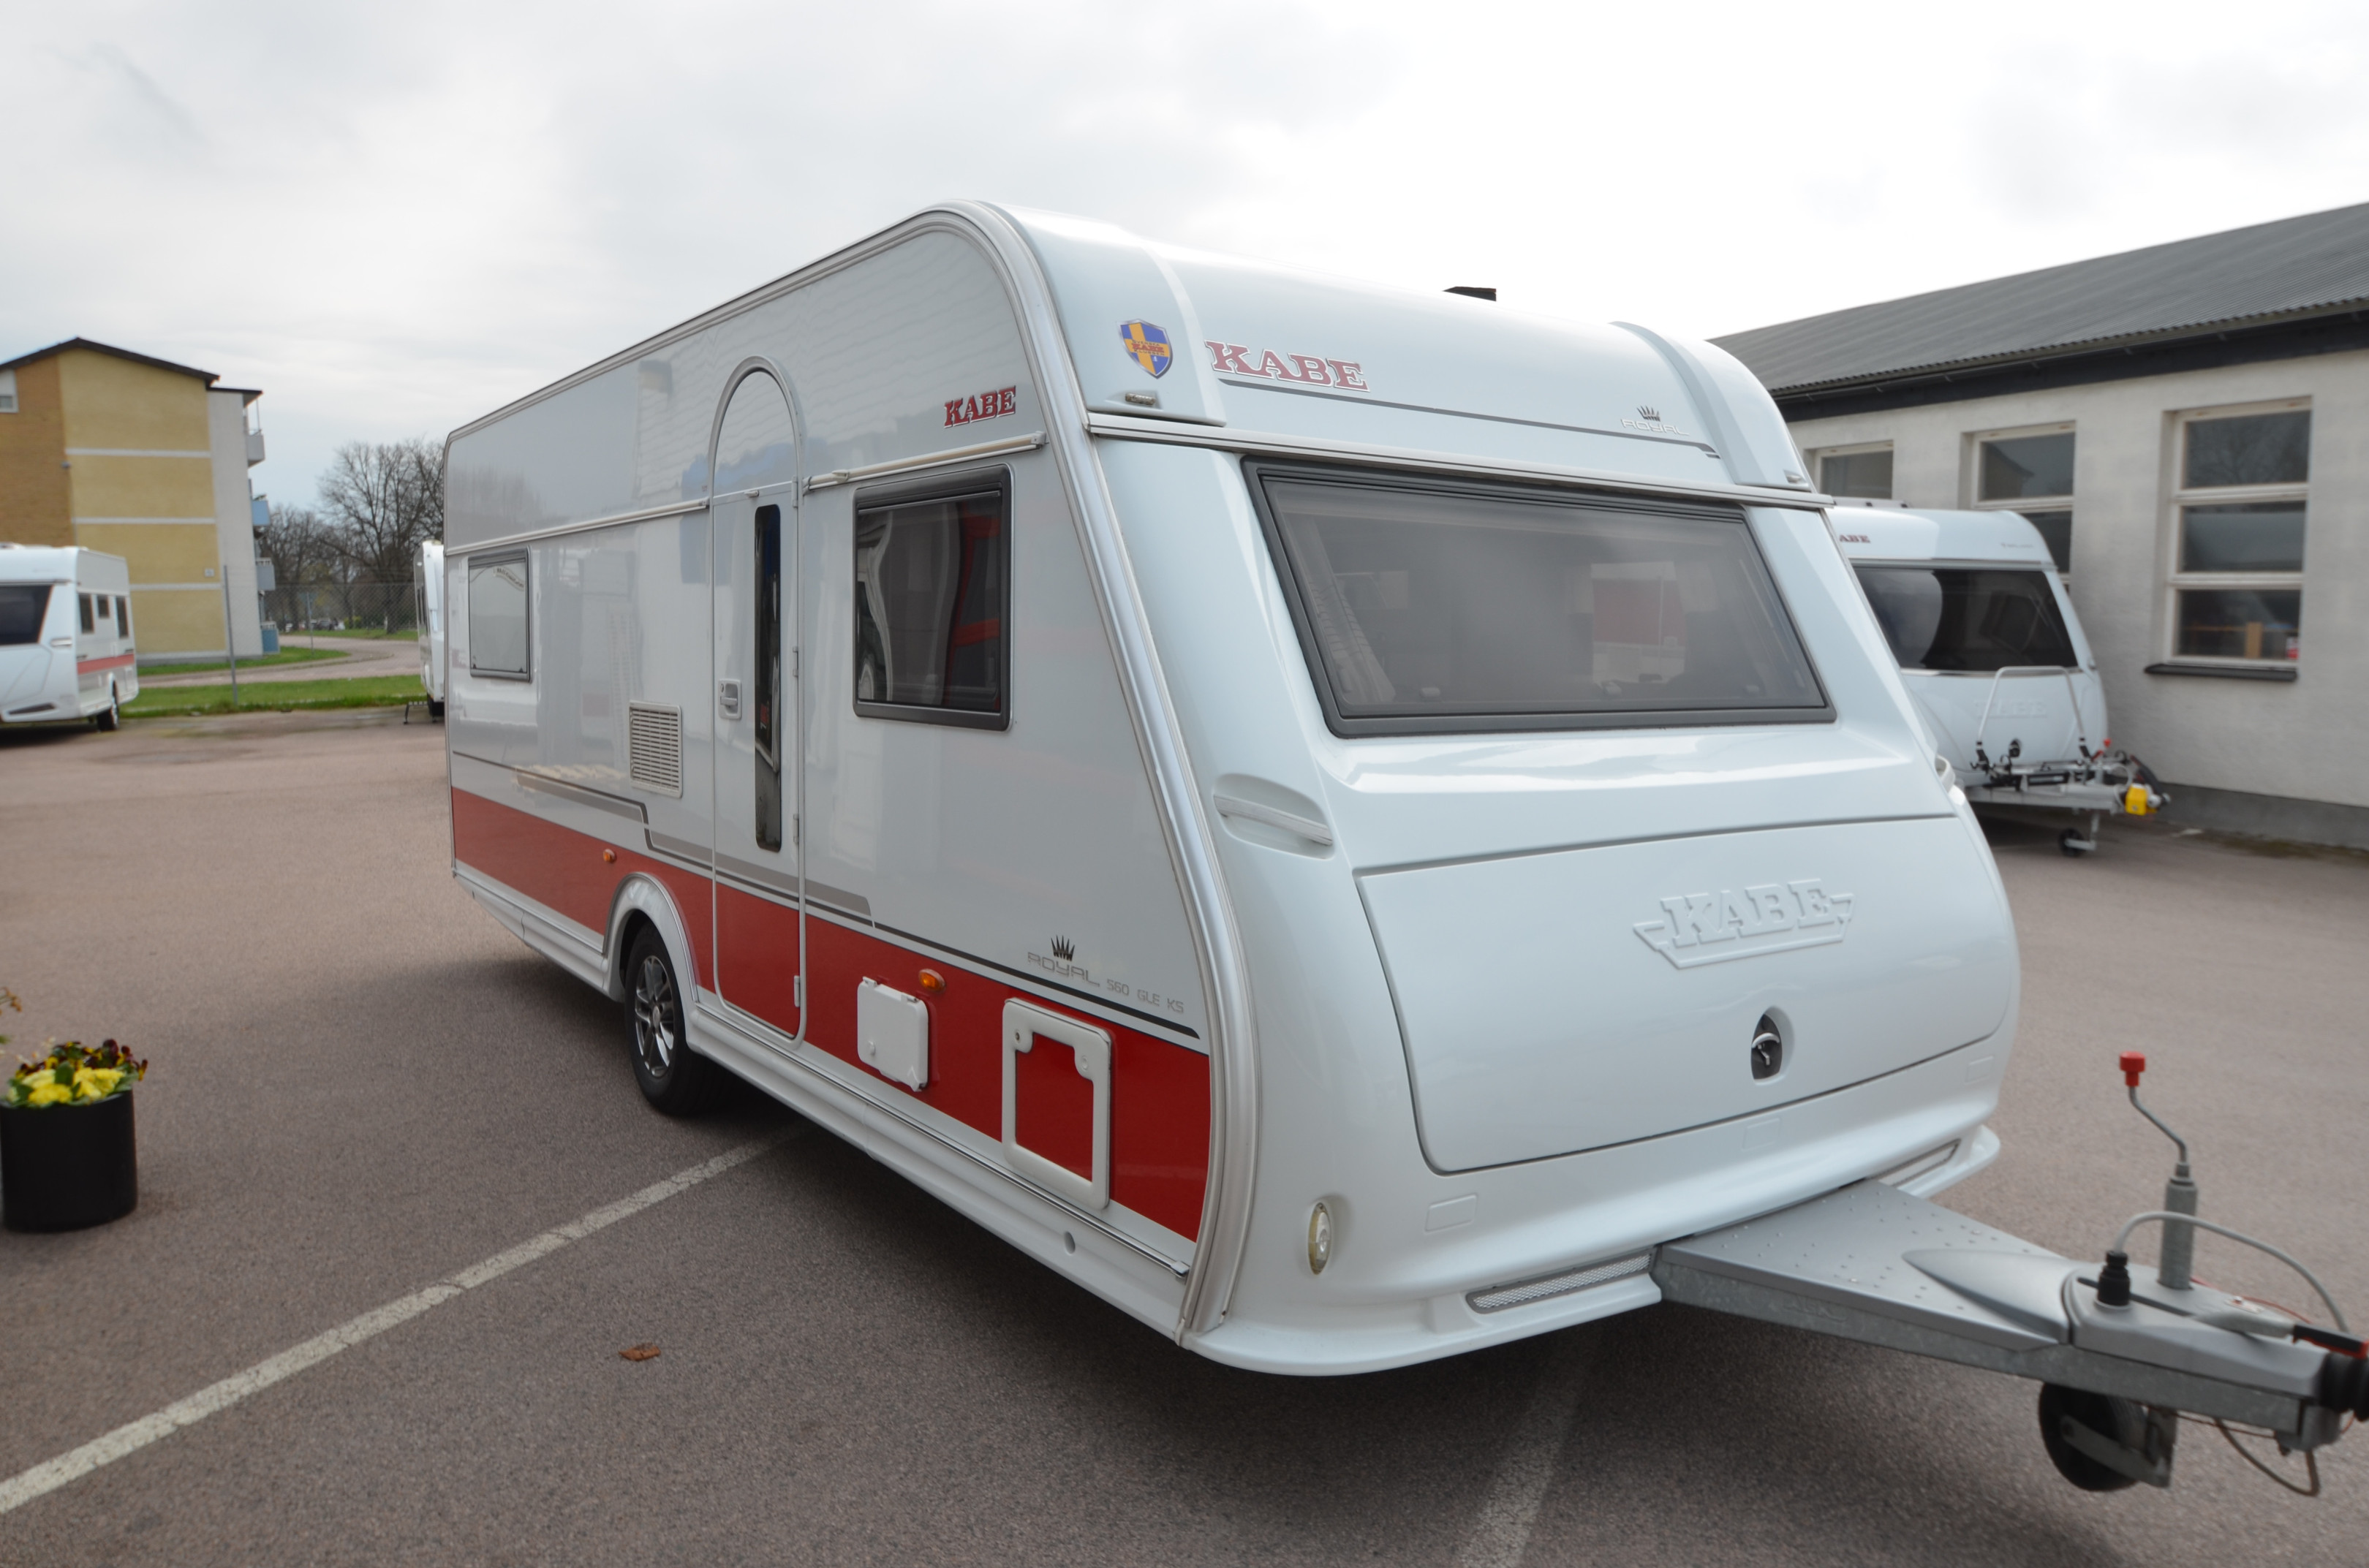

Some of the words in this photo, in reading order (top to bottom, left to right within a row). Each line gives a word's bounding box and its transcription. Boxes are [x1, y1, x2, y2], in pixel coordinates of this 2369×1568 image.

[1204, 339, 1370, 393] KABE
[944, 385, 1016, 428] KABE
[1620, 419, 1690, 436] ROYAL
[1840, 534, 1871, 544] ABE
[1660, 878, 1836, 949] KABE
[1027, 952, 1100, 987] ROYAL
[1106, 978, 1130, 996] 560
[1137, 988, 1161, 1007] GLE
[1167, 997, 1184, 1014] KS
